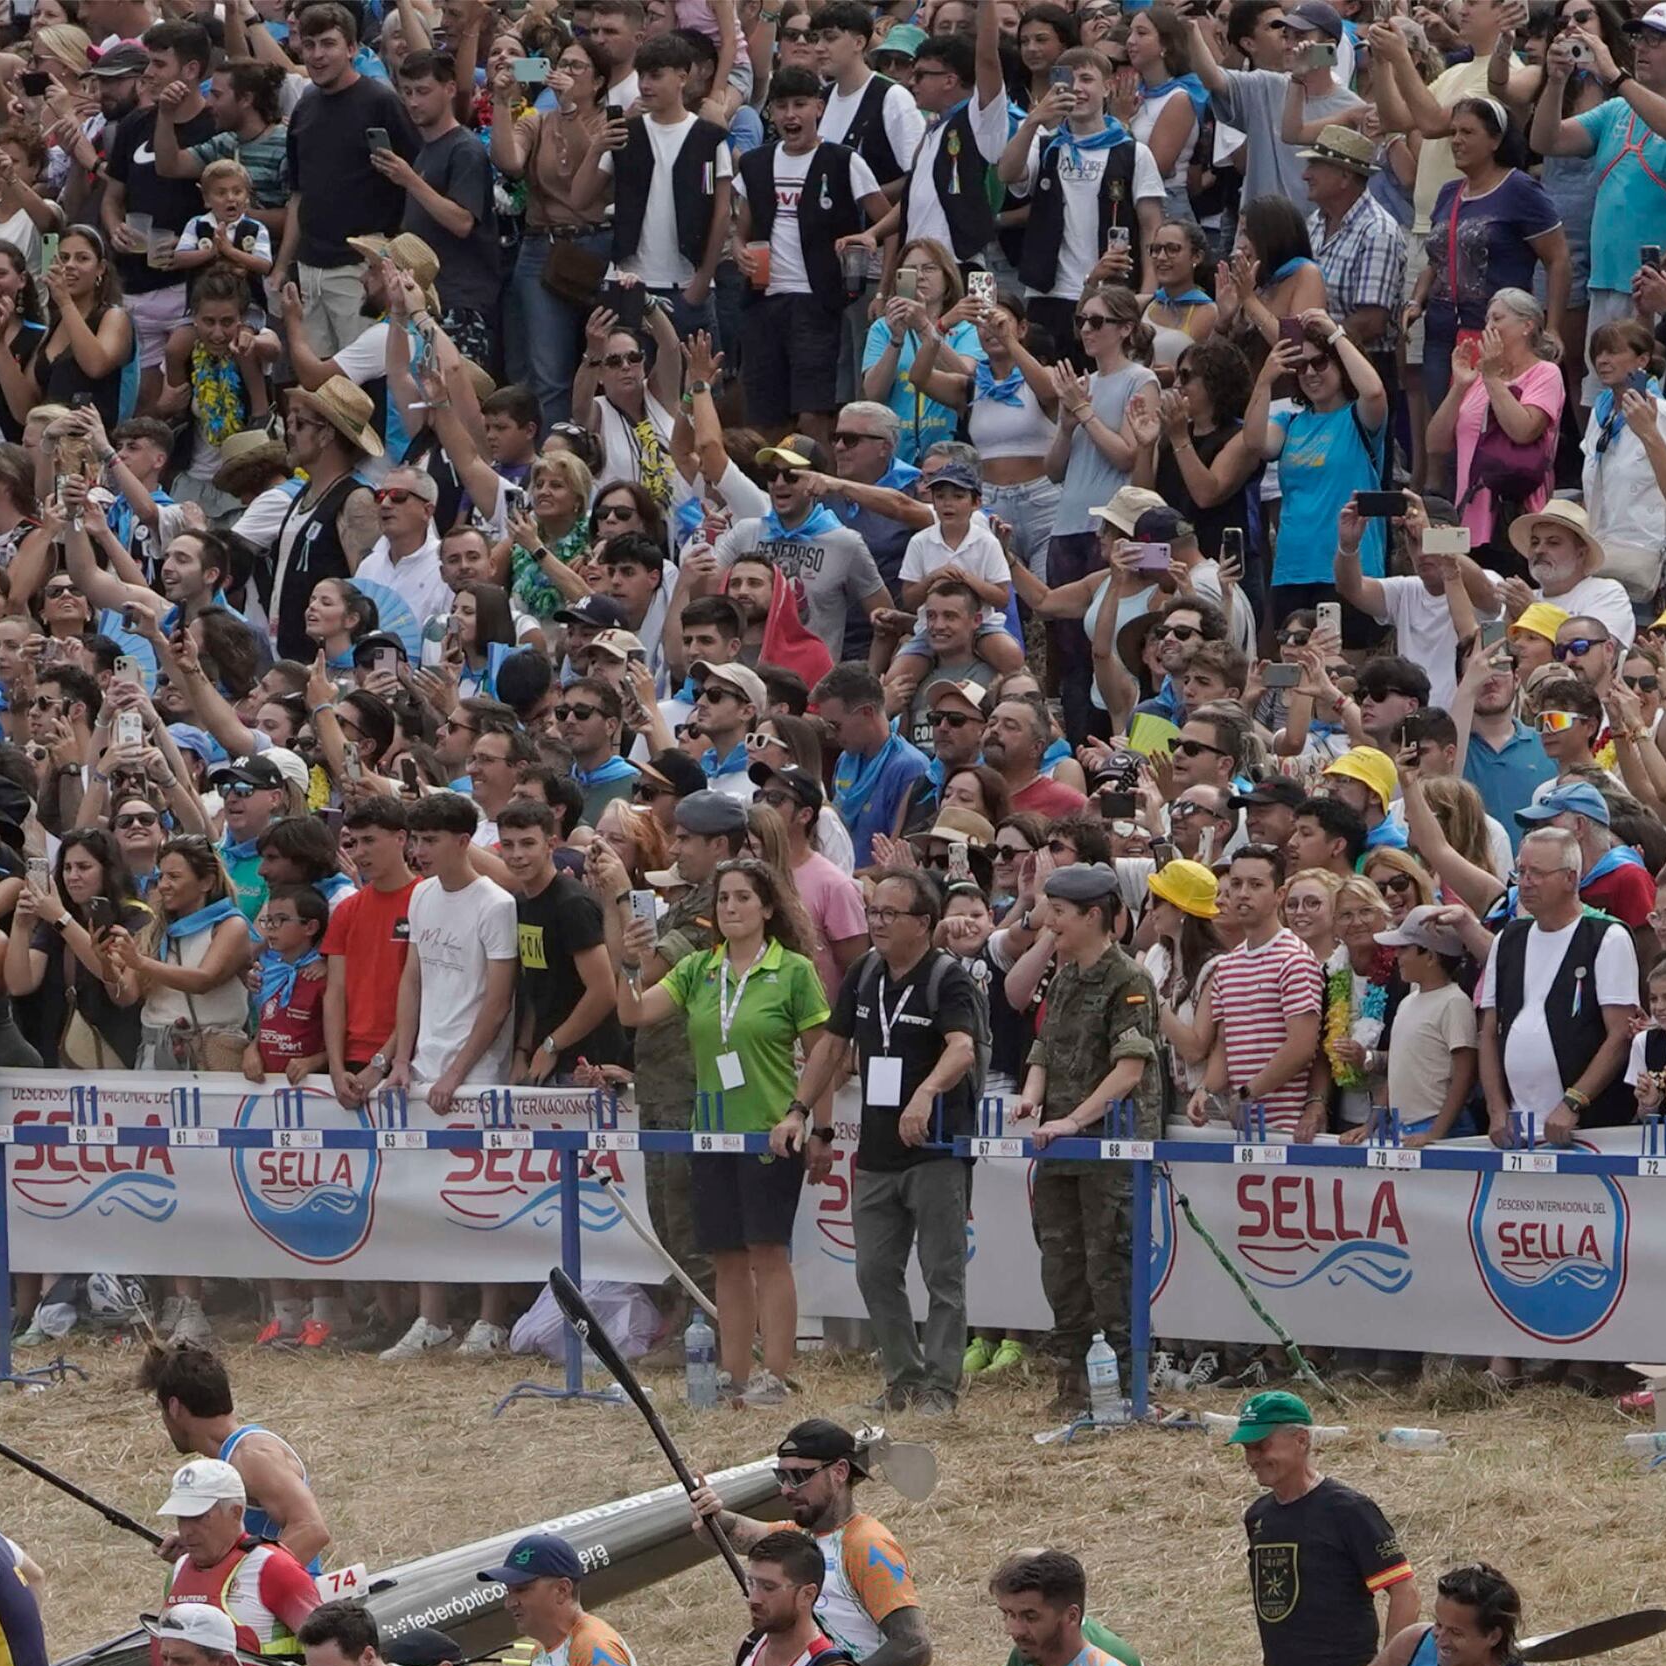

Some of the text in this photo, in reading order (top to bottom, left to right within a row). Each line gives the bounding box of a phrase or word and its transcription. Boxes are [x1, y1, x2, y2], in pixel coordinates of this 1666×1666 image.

[755, 541, 825, 573] GENEROSO
[77, 1129, 87, 1142] 60
[177, 1131, 186, 1144] 61
[280, 1134, 291, 1146] 62
[385, 1134, 395, 1146] 63
[491, 1134, 501, 1147] 64
[596, 1136, 606, 1148] 65
[13, 1110, 175, 1175] SELLA
[701, 1137, 712, 1149] 66
[979, 1142, 990, 1154] 67
[1109, 1144, 1121, 1157] 68
[1241, 1149, 1253, 1162] 69
[1376, 1152, 1387, 1165] 70
[1512, 1156, 1522, 1169] 71
[258, 1150, 355, 1189] SELLA
[1647, 1161, 1659, 1174] 72
[1237, 1174, 1409, 1245] SELLA
[1497, 1197, 1607, 1214] DESCENSO INTERNACIONAL DEL
[1497, 1220, 1602, 1261] SELLA
[328, 1570, 356, 1593] 74
[177, 1595, 208, 1603] GAITERO
[407, 1578, 509, 1629] federópticos
